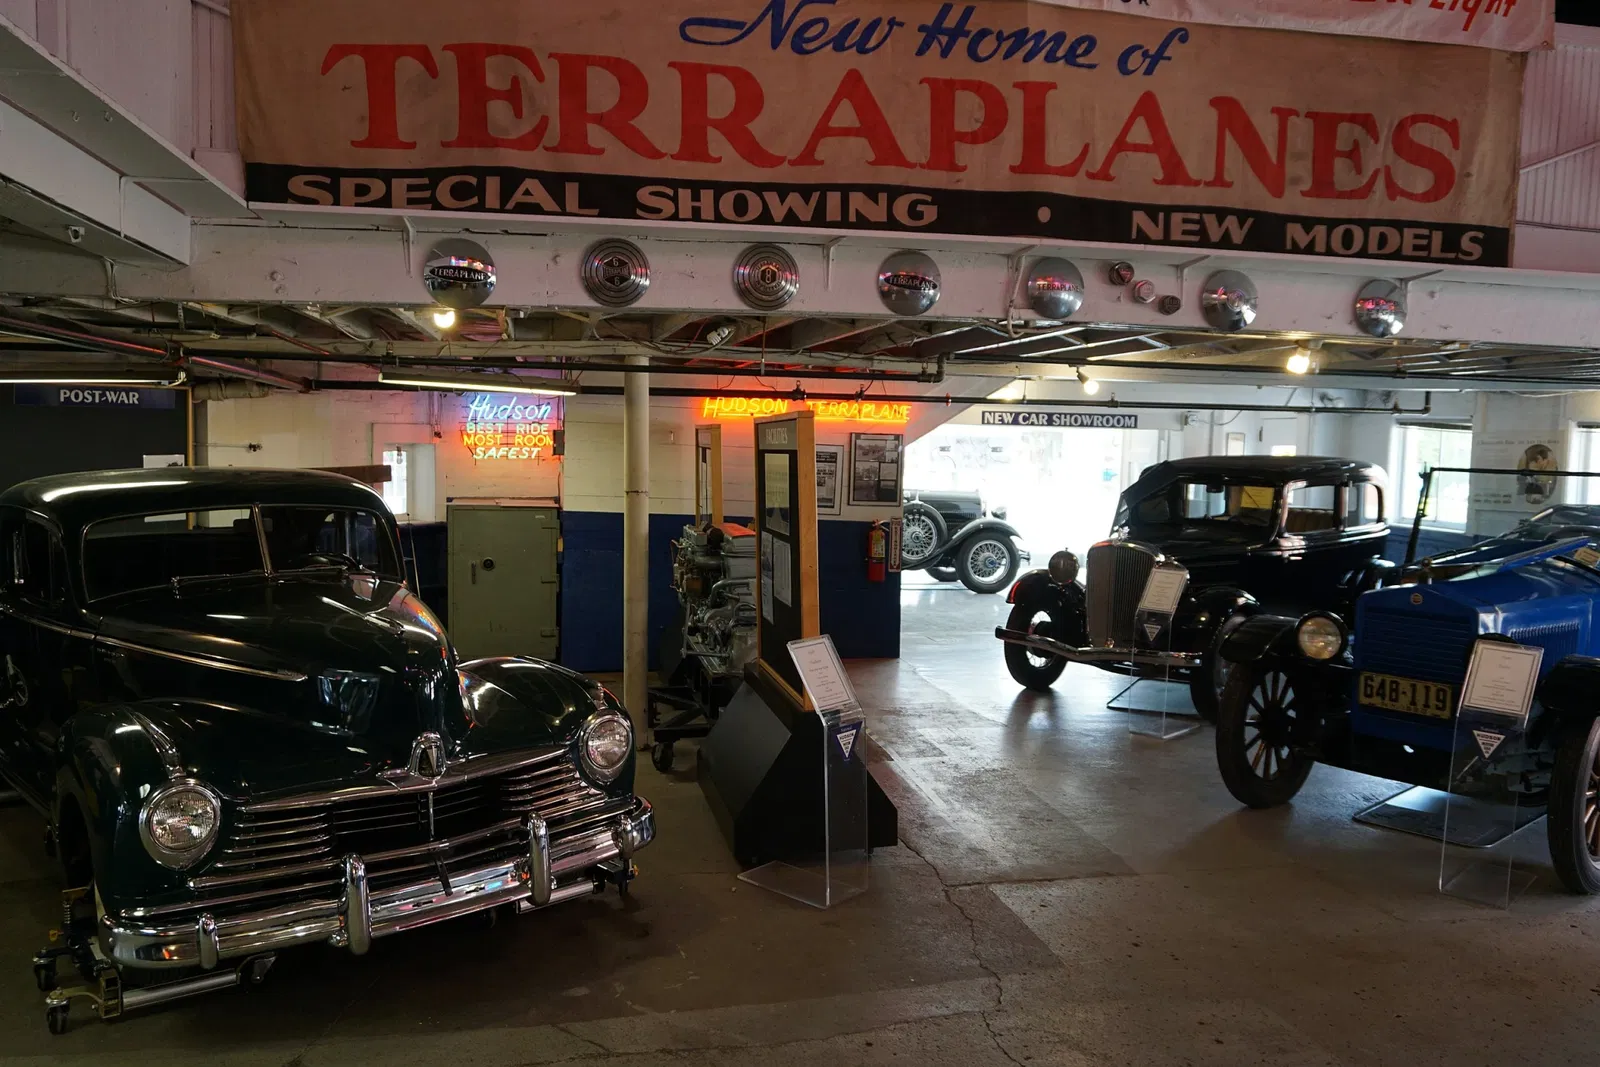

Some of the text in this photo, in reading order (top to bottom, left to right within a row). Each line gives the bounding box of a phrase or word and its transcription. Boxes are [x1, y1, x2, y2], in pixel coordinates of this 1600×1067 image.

[678, 0, 1189, 76] New Home of
[321, 42, 1462, 204] TERRAPLANES
[286, 173, 1484, 261] SPECIAL SHOWING NEW MODELS
[612, 257, 620, 267] 6
[432, 267, 487, 281] TERRAPLANE
[614, 276, 621, 286] 6
[765, 268, 772, 284] 8
[59, 389, 139, 405] POST-WAR
[467, 394, 552, 421] Hudson
[703, 397, 912, 420] HUDSON TERRAPLANE
[983, 412, 1136, 428] NEW CAR SHOWROOM
[466, 422, 549, 435] BEST RIDE
[463, 434, 503, 446] MOST
[473, 446, 542, 459] SAFEST
[1363, 676, 1448, 711] 648-119
